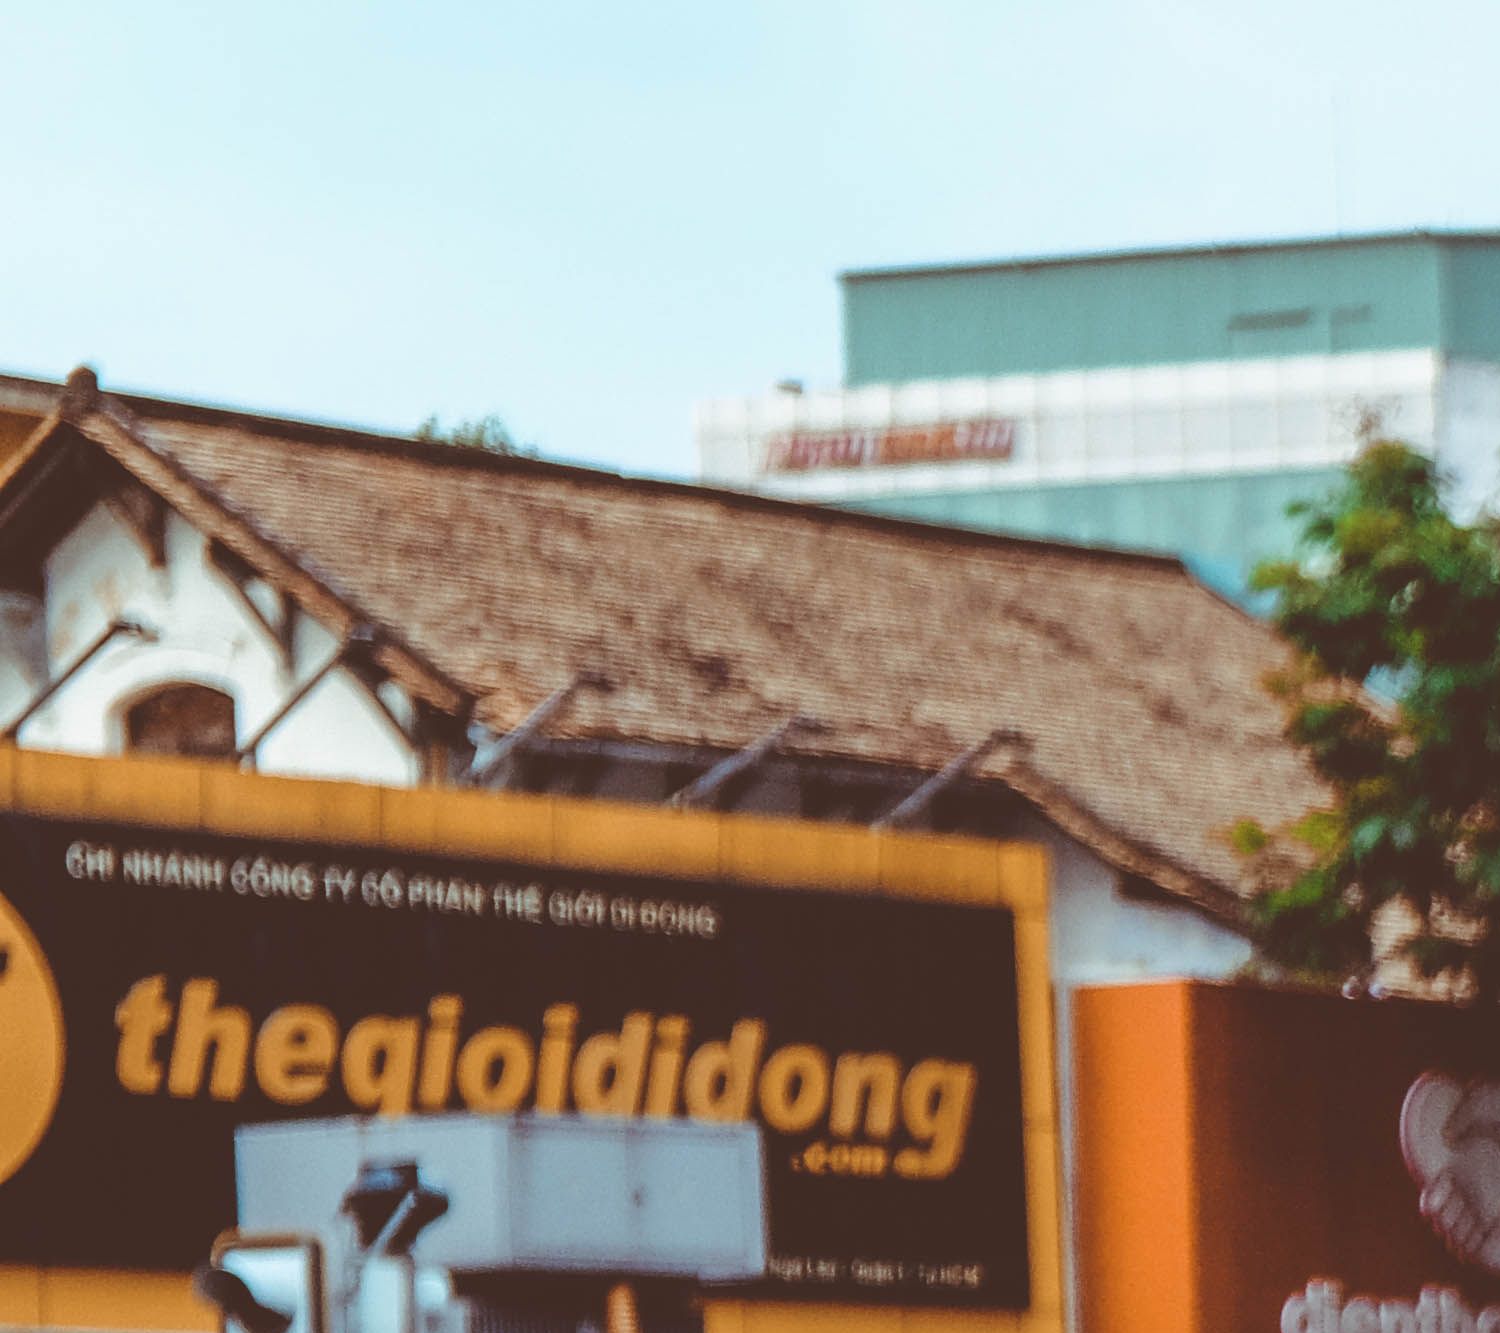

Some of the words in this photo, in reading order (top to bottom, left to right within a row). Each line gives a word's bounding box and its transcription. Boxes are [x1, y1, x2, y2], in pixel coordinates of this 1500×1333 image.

[66, 841, 113, 880] CHI
[230, 852, 315, 901] CÔNG
[322, 862, 357, 903] TY
[114, 972, 978, 1180] thegioididong
